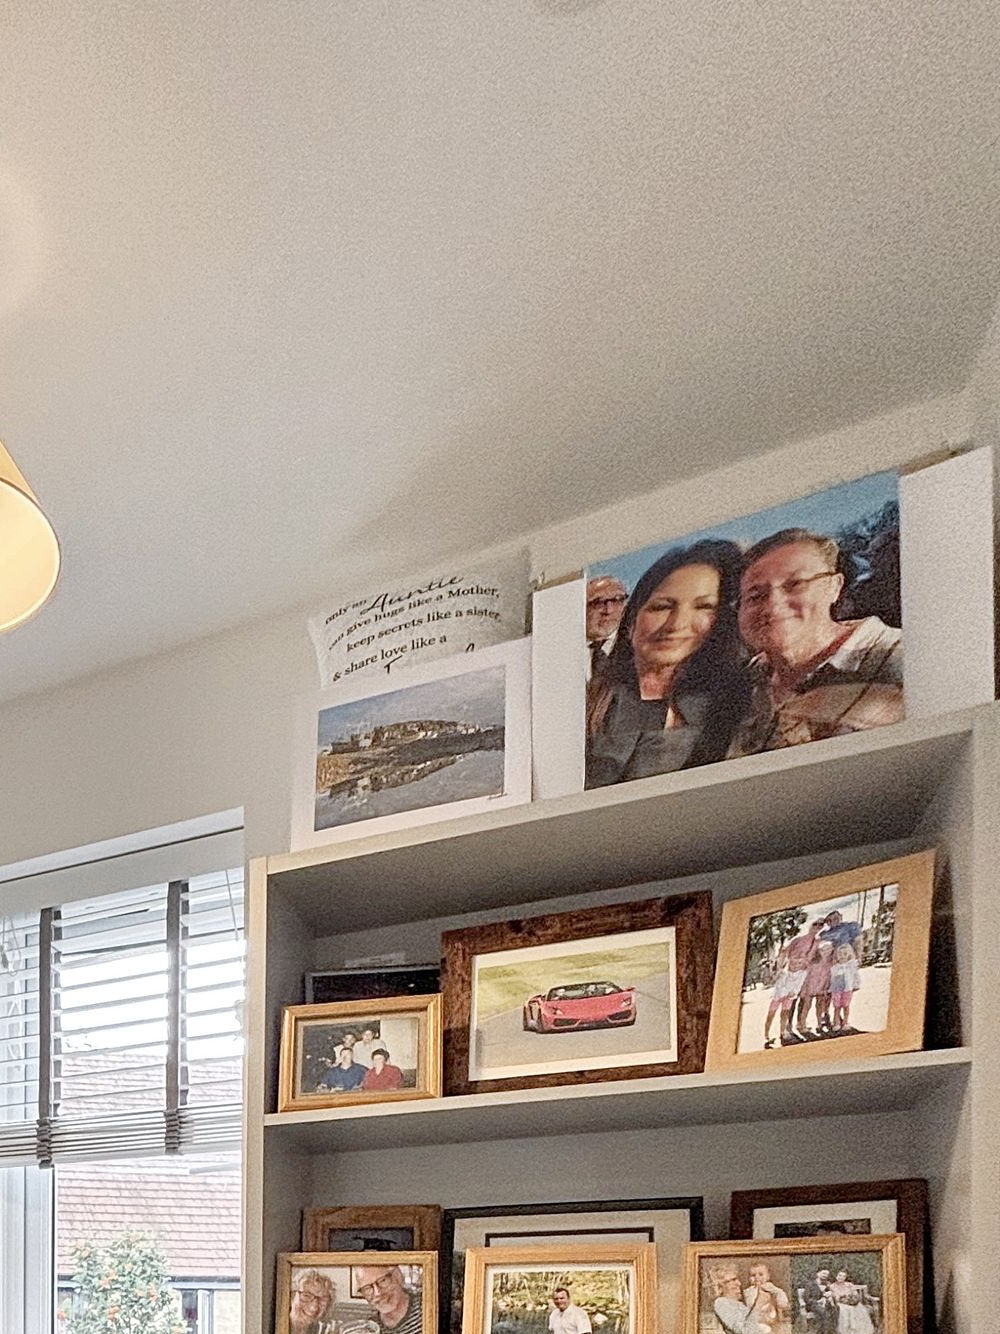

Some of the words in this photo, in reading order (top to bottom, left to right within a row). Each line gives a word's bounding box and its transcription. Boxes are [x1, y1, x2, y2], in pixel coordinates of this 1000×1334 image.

[346, 618, 371, 636] give
[374, 606, 405, 622] hugs
[408, 596, 432, 610] like
[435, 593, 444, 601] a
[447, 584, 500, 599] Mother,
[360, 576, 464, 616] Auntie
[346, 634, 375, 653] keep
[377, 618, 424, 639] secrets
[426, 610, 452, 623] like
[455, 609, 463, 618] a
[332, 671, 342, 682] &
[344, 654, 378, 676] share
[381, 644, 408, 661] love
[411, 637, 436, 651] like
[438, 634, 447, 644] a
